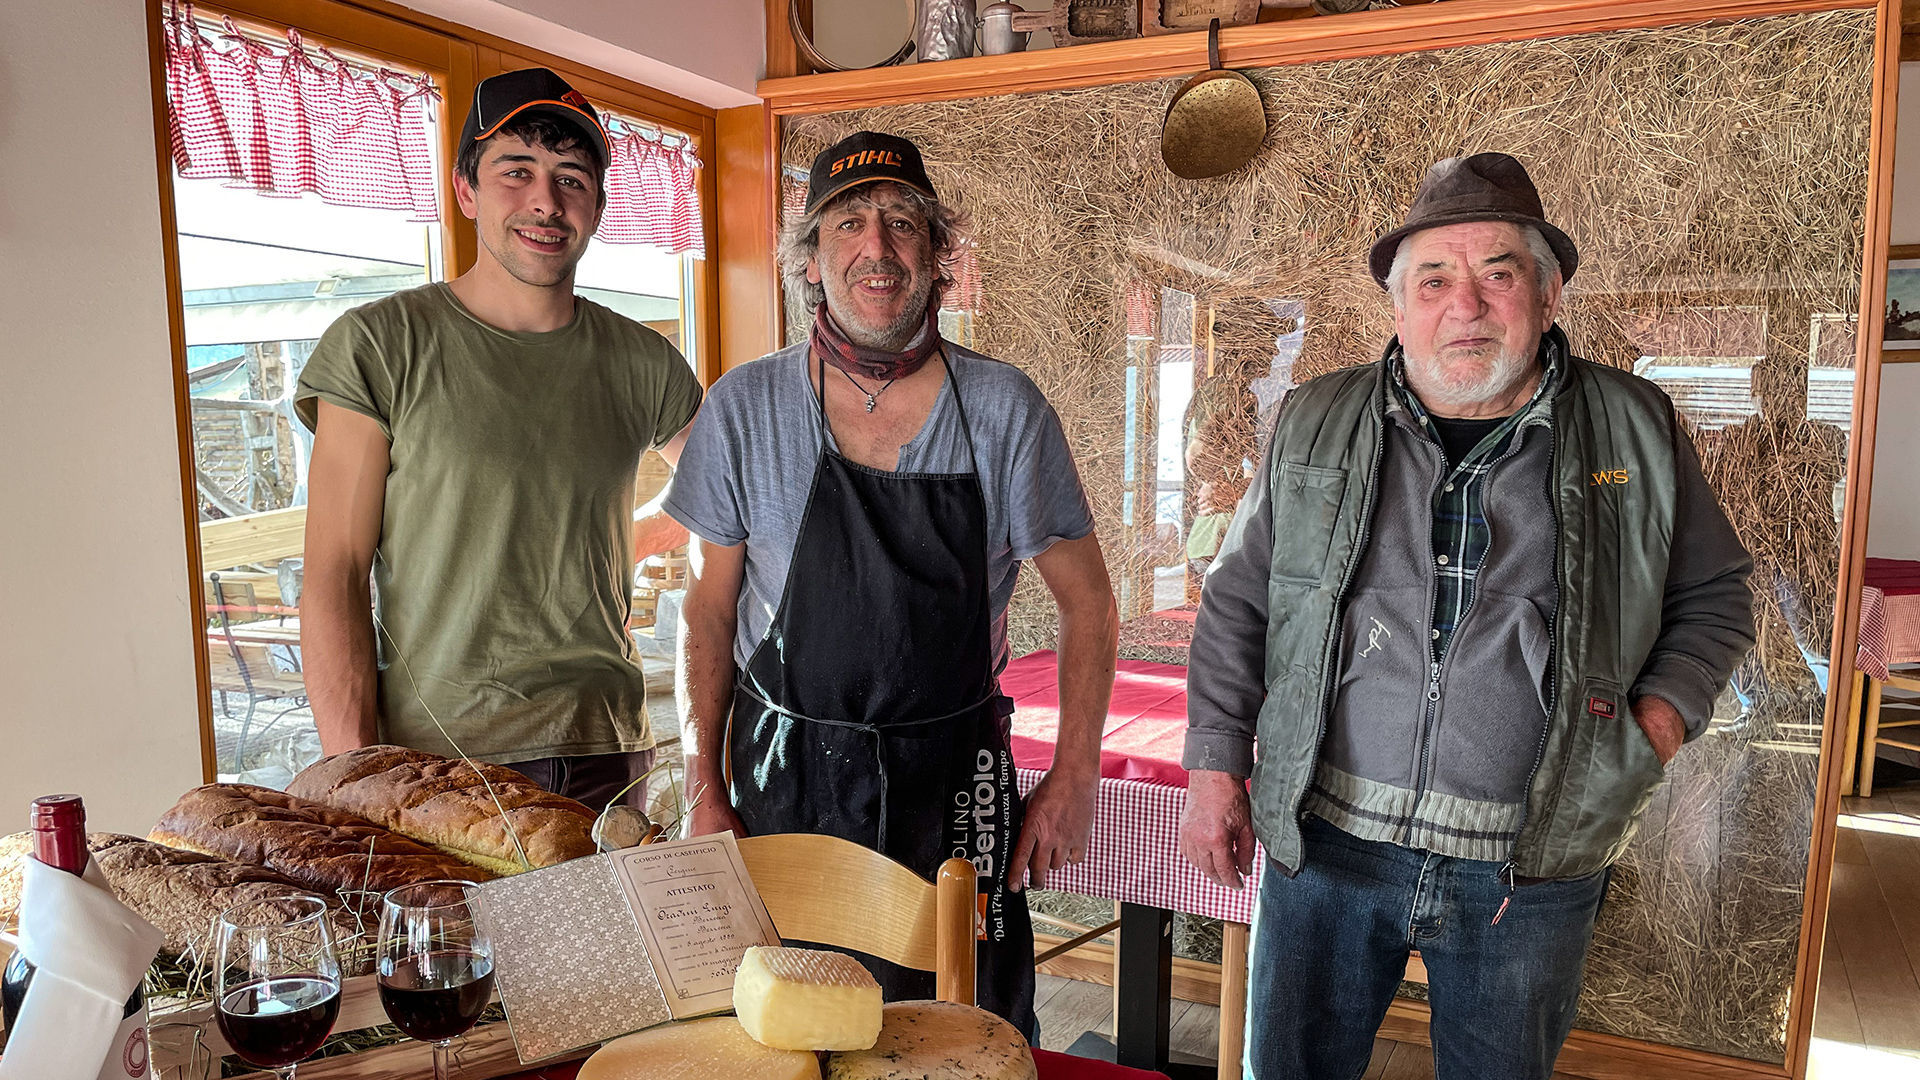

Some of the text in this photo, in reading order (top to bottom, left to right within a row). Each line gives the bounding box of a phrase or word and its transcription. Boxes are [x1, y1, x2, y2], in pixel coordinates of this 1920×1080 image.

[830, 150, 902, 178] STIHL
[1589, 468, 1629, 486] WS
[999, 750, 1010, 790] Tempo
[952, 791, 971, 859] OLINO
[971, 749, 996, 878] Bertolo
[633, 855, 662, 864] CORSO
[674, 846, 717, 858] CASEIFICIO
[666, 883, 716, 897] ATTESTATO
[994, 916, 1005, 942] Dal
